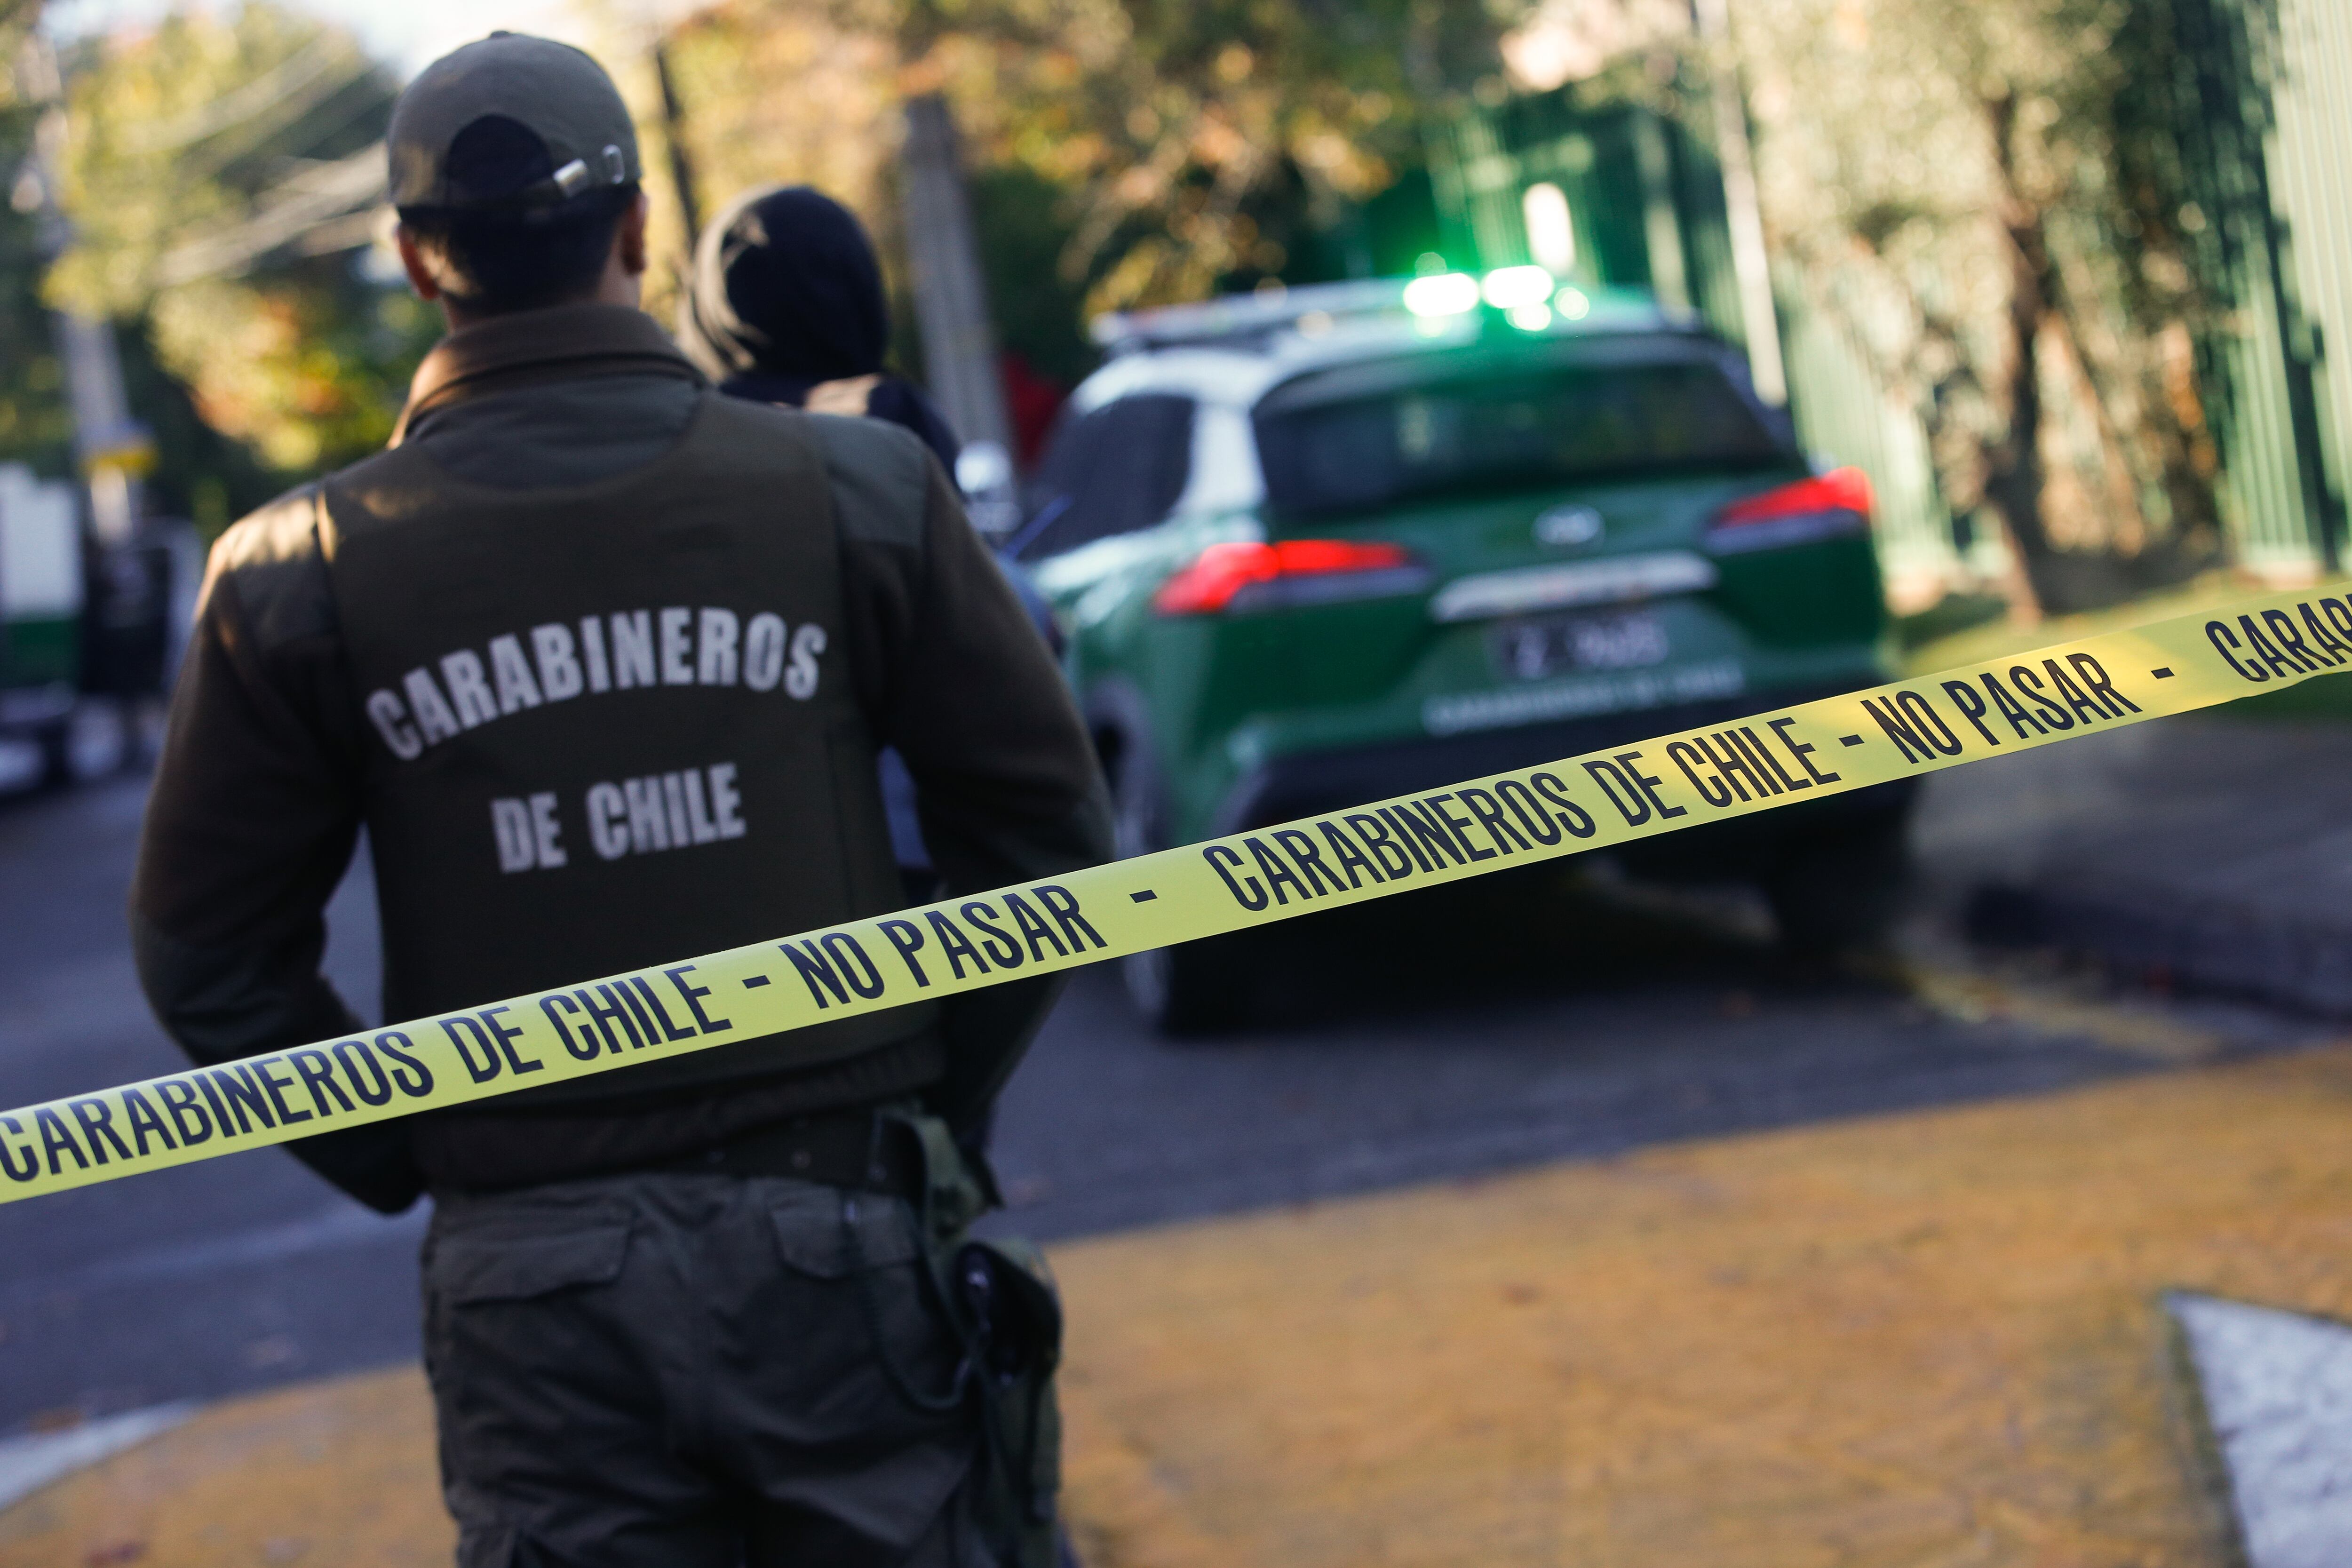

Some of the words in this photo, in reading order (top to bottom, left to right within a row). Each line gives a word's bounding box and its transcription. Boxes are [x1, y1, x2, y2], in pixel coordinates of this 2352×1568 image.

[366, 606, 828, 761] CARABINEROS
[0, 1031, 435, 1182] CARABINEROS
[437, 1006, 545, 1084] DE
[539, 964, 733, 1061] CHILE
[777, 931, 885, 1010] NO
[875, 884, 1109, 988] PASAR
[1202, 772, 1597, 912] CARABINEROS
[1580, 750, 1689, 828] DE
[1666, 716, 1843, 808] CHILE
[1859, 690, 1963, 765] NO
[1939, 653, 2144, 747] PASAR
[2205, 593, 2352, 683] CARAB
[490, 791, 568, 874] DE
[585, 762, 746, 860] CHILE
